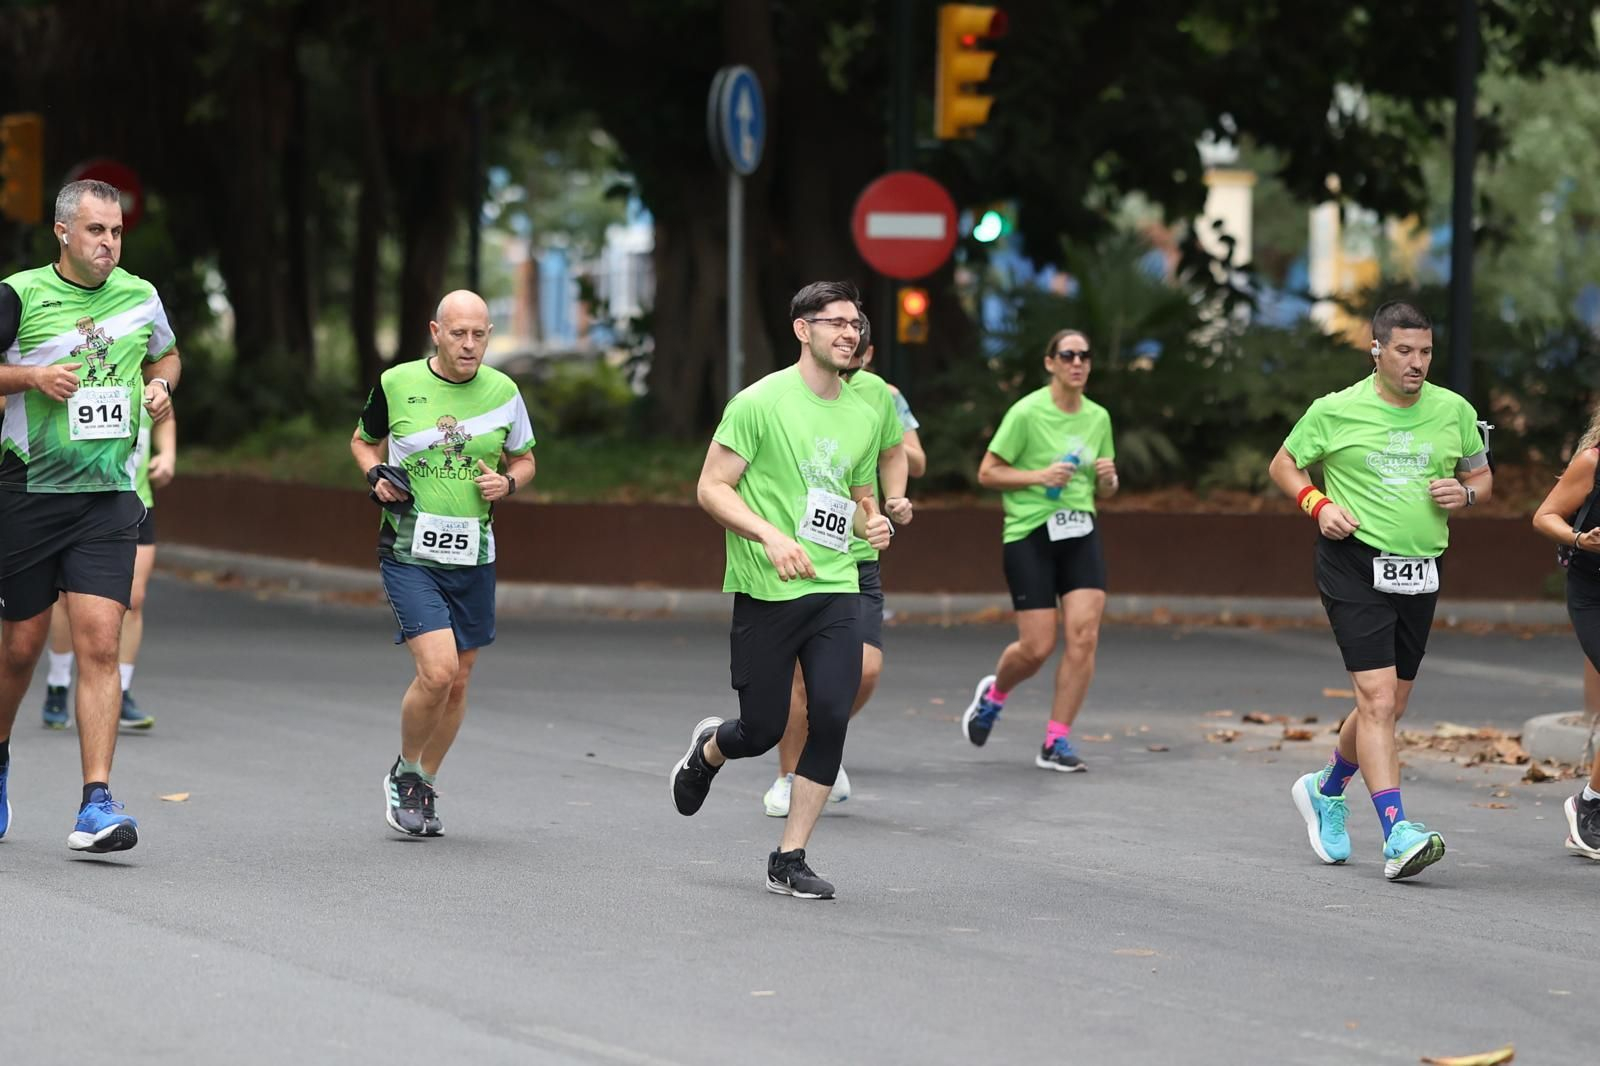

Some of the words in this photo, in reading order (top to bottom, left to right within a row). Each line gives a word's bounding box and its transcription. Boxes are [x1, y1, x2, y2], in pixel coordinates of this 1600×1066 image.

[78, 404, 122, 424] 914
[812, 508, 846, 535] 508
[422, 530, 469, 550] 925
[1383, 563, 1424, 581] 841
